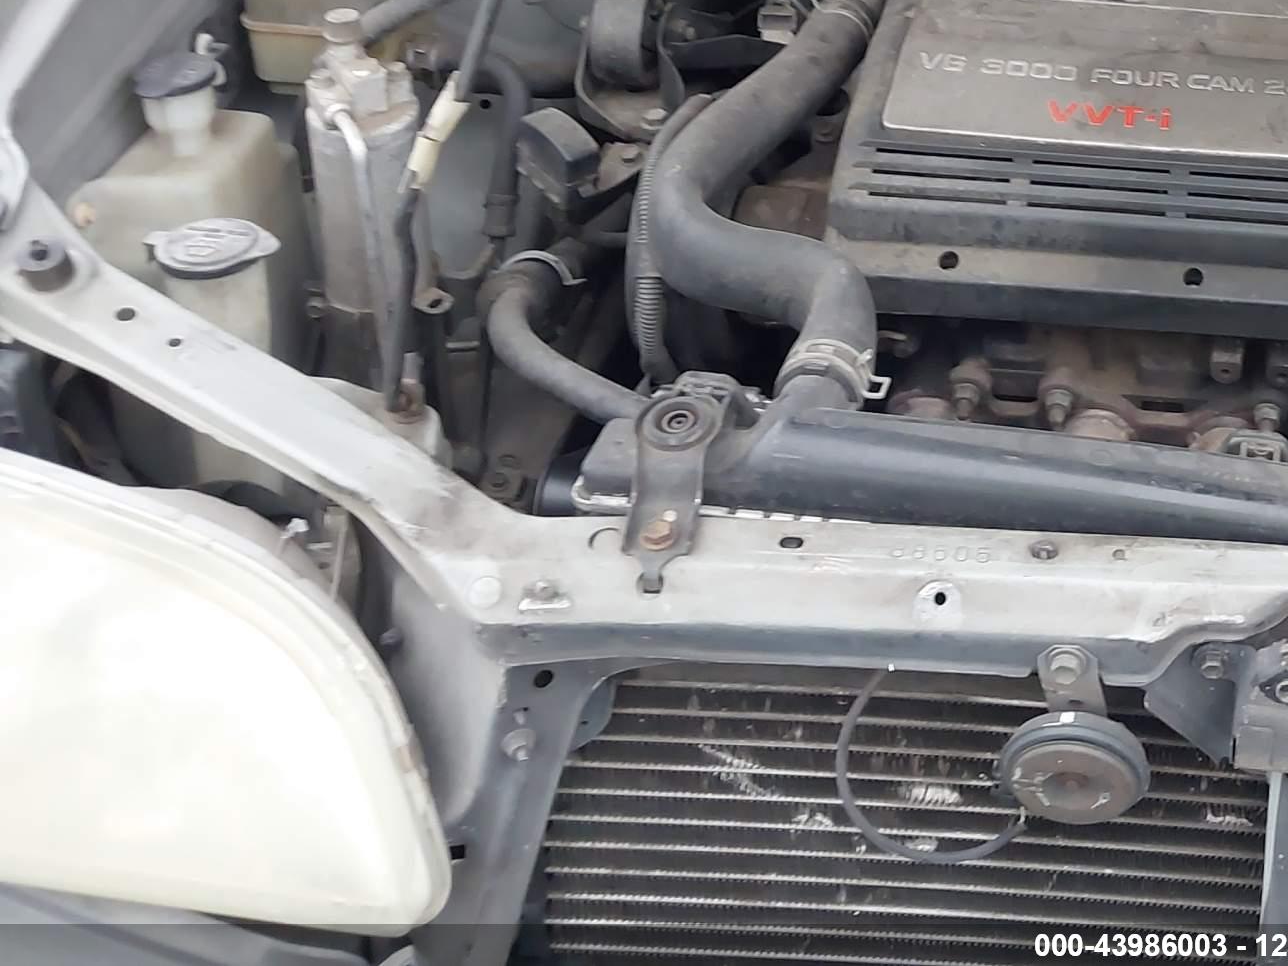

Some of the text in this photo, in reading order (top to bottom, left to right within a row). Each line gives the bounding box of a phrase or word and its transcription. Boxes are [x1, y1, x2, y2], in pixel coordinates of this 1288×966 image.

[919, 51, 968, 72] V6
[980, 58, 1078, 81] 3000
[1090, 67, 1181, 89] FOUR
[1186, 73, 1255, 94] CAM
[1047, 99, 1172, 131] VVT-i
